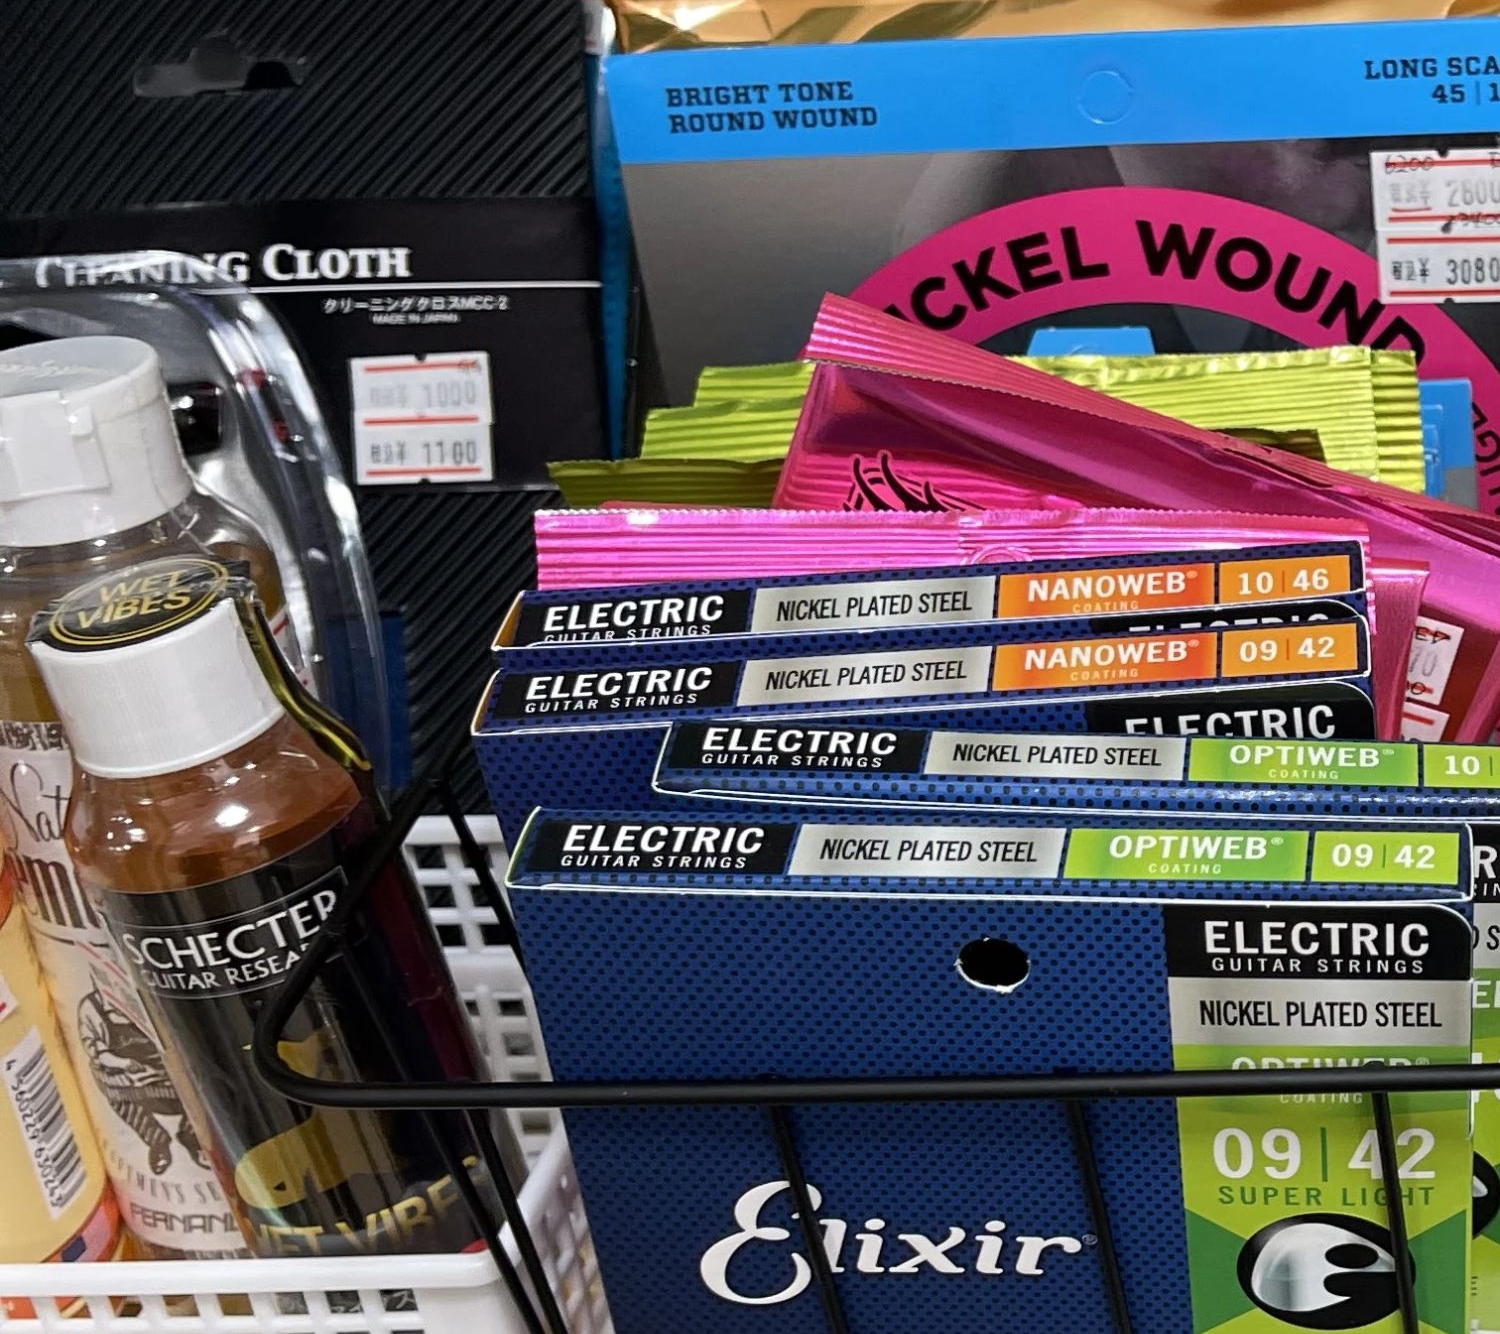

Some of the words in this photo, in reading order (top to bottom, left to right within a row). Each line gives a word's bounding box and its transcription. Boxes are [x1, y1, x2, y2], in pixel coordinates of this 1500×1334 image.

[1364, 58, 1438, 80] LONG
[665, 83, 770, 107] BRIGHT
[778, 80, 854, 103] TONE
[1431, 83, 1466, 104] 45
[669, 110, 766, 134] ROUND
[771, 106, 878, 130] WOUND
[262, 243, 413, 281] CLOTH
[422, 440, 478, 466] 1100
[100, 570, 186, 604] WET
[543, 595, 724, 633] ELECTRIC
[776, 596, 842, 622] NICKEL
[846, 592, 916, 618] PLATED
[918, 590, 973, 614] STEEL
[1237, 570, 1275, 595] 10
[1292, 567, 1330, 592] 46
[76, 587, 192, 629] VIBES
[625, 623, 712, 641] STRINGS
[1072, 598, 1140, 615] COATING
[525, 666, 713, 702] ELECTRIC
[764, 666, 832, 692] NICKEL
[836, 663, 906, 688] PLATED
[910, 661, 968, 683] STEEL
[1238, 638, 1279, 664] 09
[1296, 635, 1336, 660] 42
[524, 698, 598, 715] GUITAR
[610, 693, 698, 711] STRINGS
[1069, 667, 1140, 683] COATING
[701, 726, 898, 755] ELECTRIC
[952, 743, 1022, 765] NICKEL
[1027, 745, 1098, 766] PLATED
[1104, 747, 1162, 768] STEEL
[1443, 755, 1480, 776] 10
[701, 751, 780, 767] GUITAR
[791, 753, 882, 769] STRINGS
[1267, 768, 1340, 781] COATING
[562, 823, 766, 855] ELECTRIC
[819, 837, 893, 861] NICKEL
[897, 838, 971, 862] PLATED
[977, 839, 1038, 863] STEEL
[1330, 842, 1374, 869] 09
[1394, 843, 1436, 870] 42
[561, 853, 641, 868] GUITAR
[651, 854, 748, 870] STRINGS
[1148, 861, 1222, 876] COATING
[1204, 919, 1431, 958] ELECTRIC
[227, 942, 312, 987] RESEA
[1211, 957, 1302, 973] GUITAR
[1316, 958, 1425, 974] STRINGS
[1199, 999, 1280, 1027] NICKEL
[1286, 1000, 1368, 1028] PLATED
[1375, 1000, 1443, 1028] STEEL
[1212, 1127, 1302, 1180] 09
[1347, 1127, 1436, 1180] 42
[1218, 1185, 1322, 1206] SUPER
[128, 1200, 243, 1234] FERNAN
